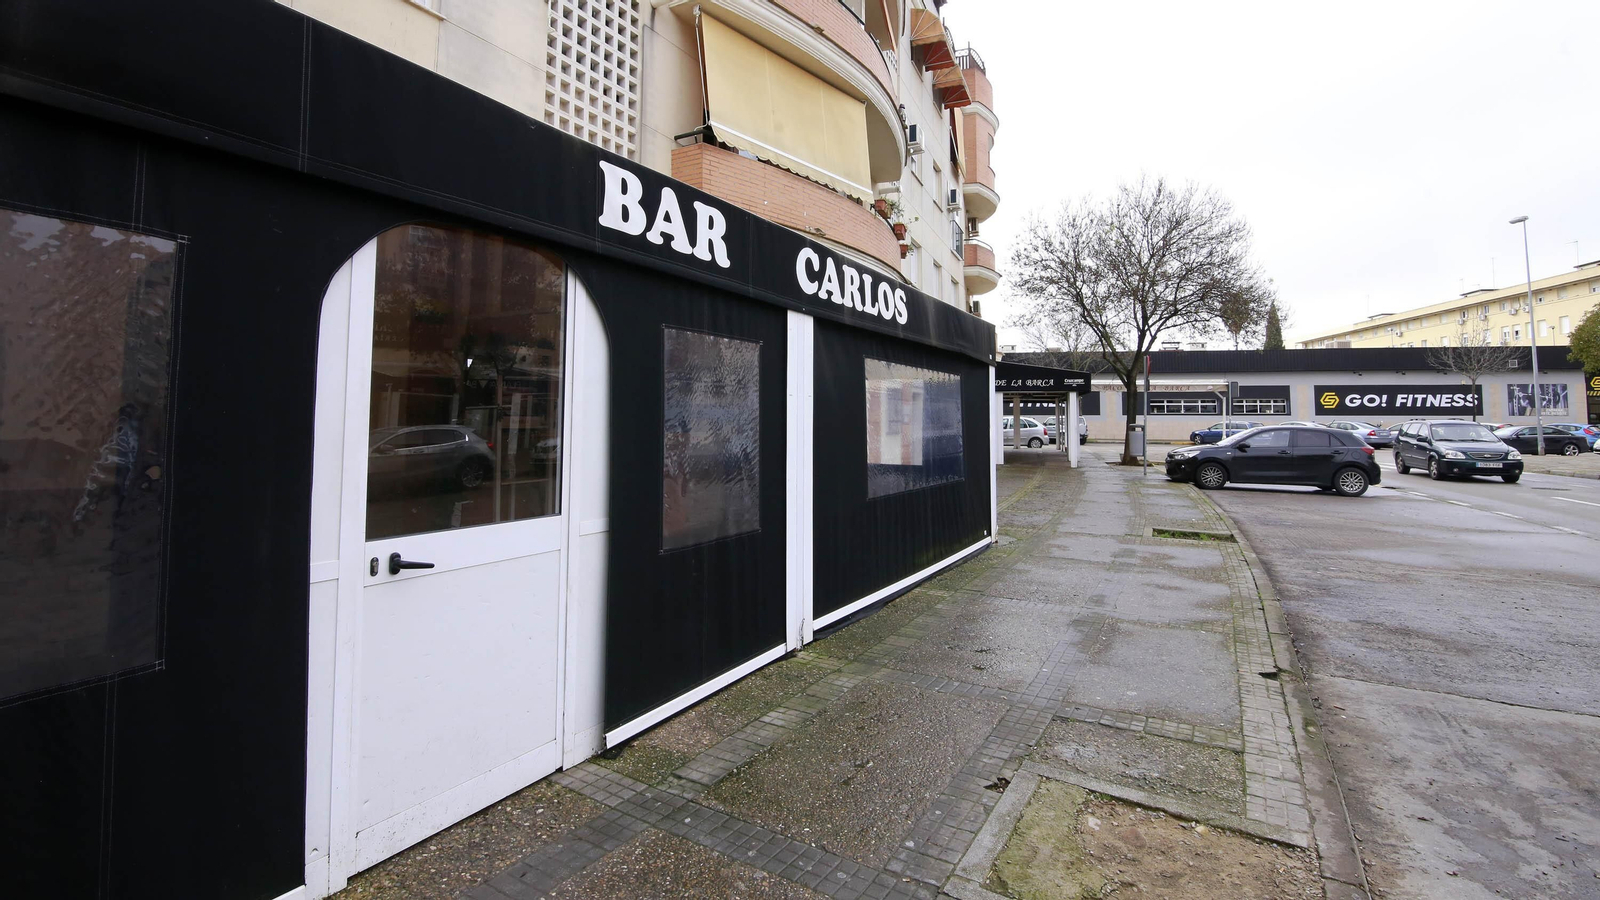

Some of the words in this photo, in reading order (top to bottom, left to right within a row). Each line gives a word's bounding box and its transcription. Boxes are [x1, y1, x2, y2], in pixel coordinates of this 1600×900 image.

[598, 160, 731, 268] BAR
[795, 247, 908, 325] CARLOS
[1010, 379, 1022, 387] LA
[1025, 379, 1054, 387] BARCA
[1345, 393, 1387, 408] GO!
[1395, 393, 1479, 408] FITNESS
